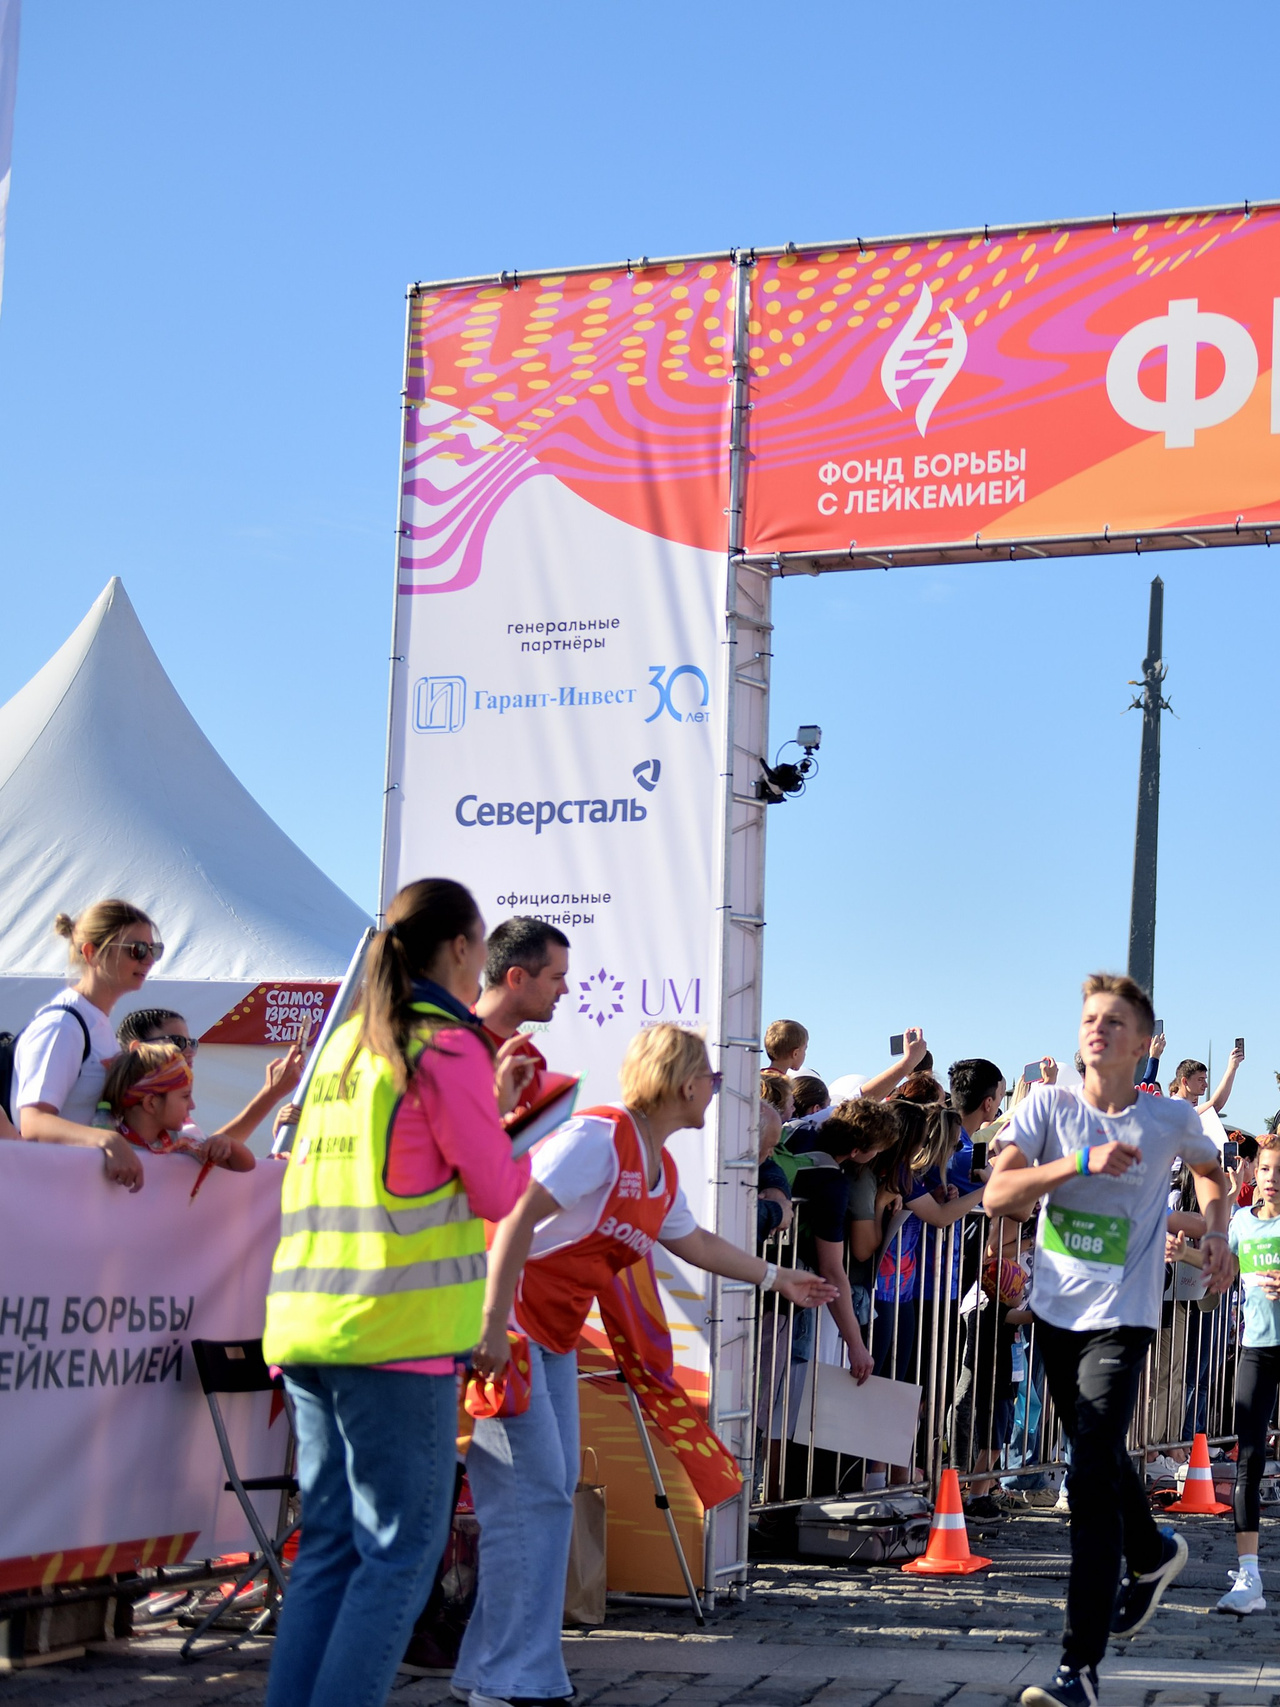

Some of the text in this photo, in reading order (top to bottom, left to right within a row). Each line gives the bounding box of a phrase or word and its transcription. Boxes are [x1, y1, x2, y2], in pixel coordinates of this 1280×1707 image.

[818, 447, 1028, 487] ФОНД БОРЬБЫ
[817, 474, 1027, 516] С ЛЕЙКЕМИЕЙ
[506, 617, 621, 639] генеральные
[520, 634, 606, 655] партнёры
[473, 685, 638, 715] Гарант-Инвест
[644, 664, 710, 724] 30
[685, 711, 711, 723] лет
[454, 794, 648, 836] Северсталь
[497, 891, 612, 909] официальные
[513, 911, 595, 927] ртнёры
[641, 978, 701, 1016] UVI
[264, 1022, 303, 1041] жит
[1063, 1231, 1104, 1254] 1088
[1252, 1252, 1280, 1267] 1104
[0, 1295, 196, 1342] НД БОРЬБЫ
[0, 1339, 184, 1391] ЕЙКЕМИЕЙ
